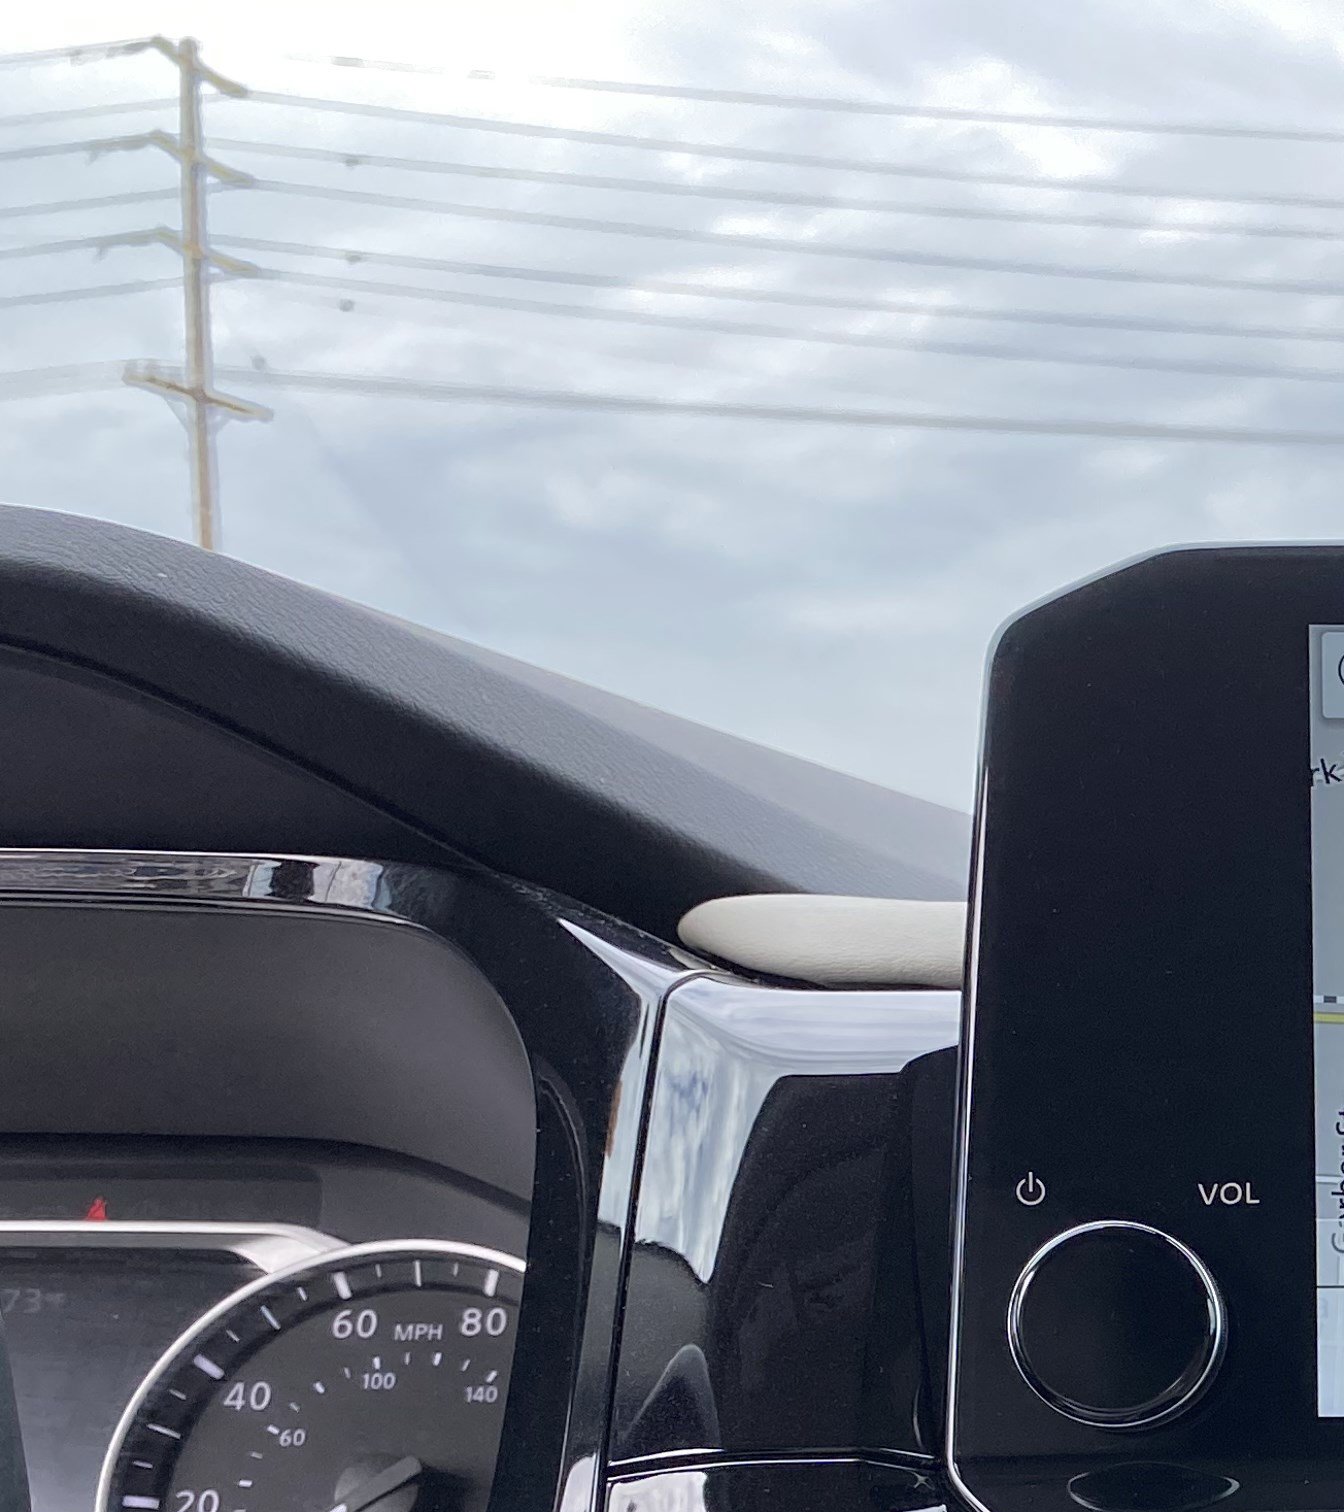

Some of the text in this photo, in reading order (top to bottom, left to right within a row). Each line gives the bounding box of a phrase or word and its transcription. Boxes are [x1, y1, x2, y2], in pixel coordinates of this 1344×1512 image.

[1197, 1182, 1260, 1205] VOL
[331, 1308, 378, 1339] 60
[393, 1322, 444, 1342] MPH
[459, 1307, 508, 1338] 80
[362, 1372, 397, 1391] 100
[223, 1381, 272, 1410] 40
[465, 1385, 499, 1405] 140
[278, 1429, 306, 1448] 60
